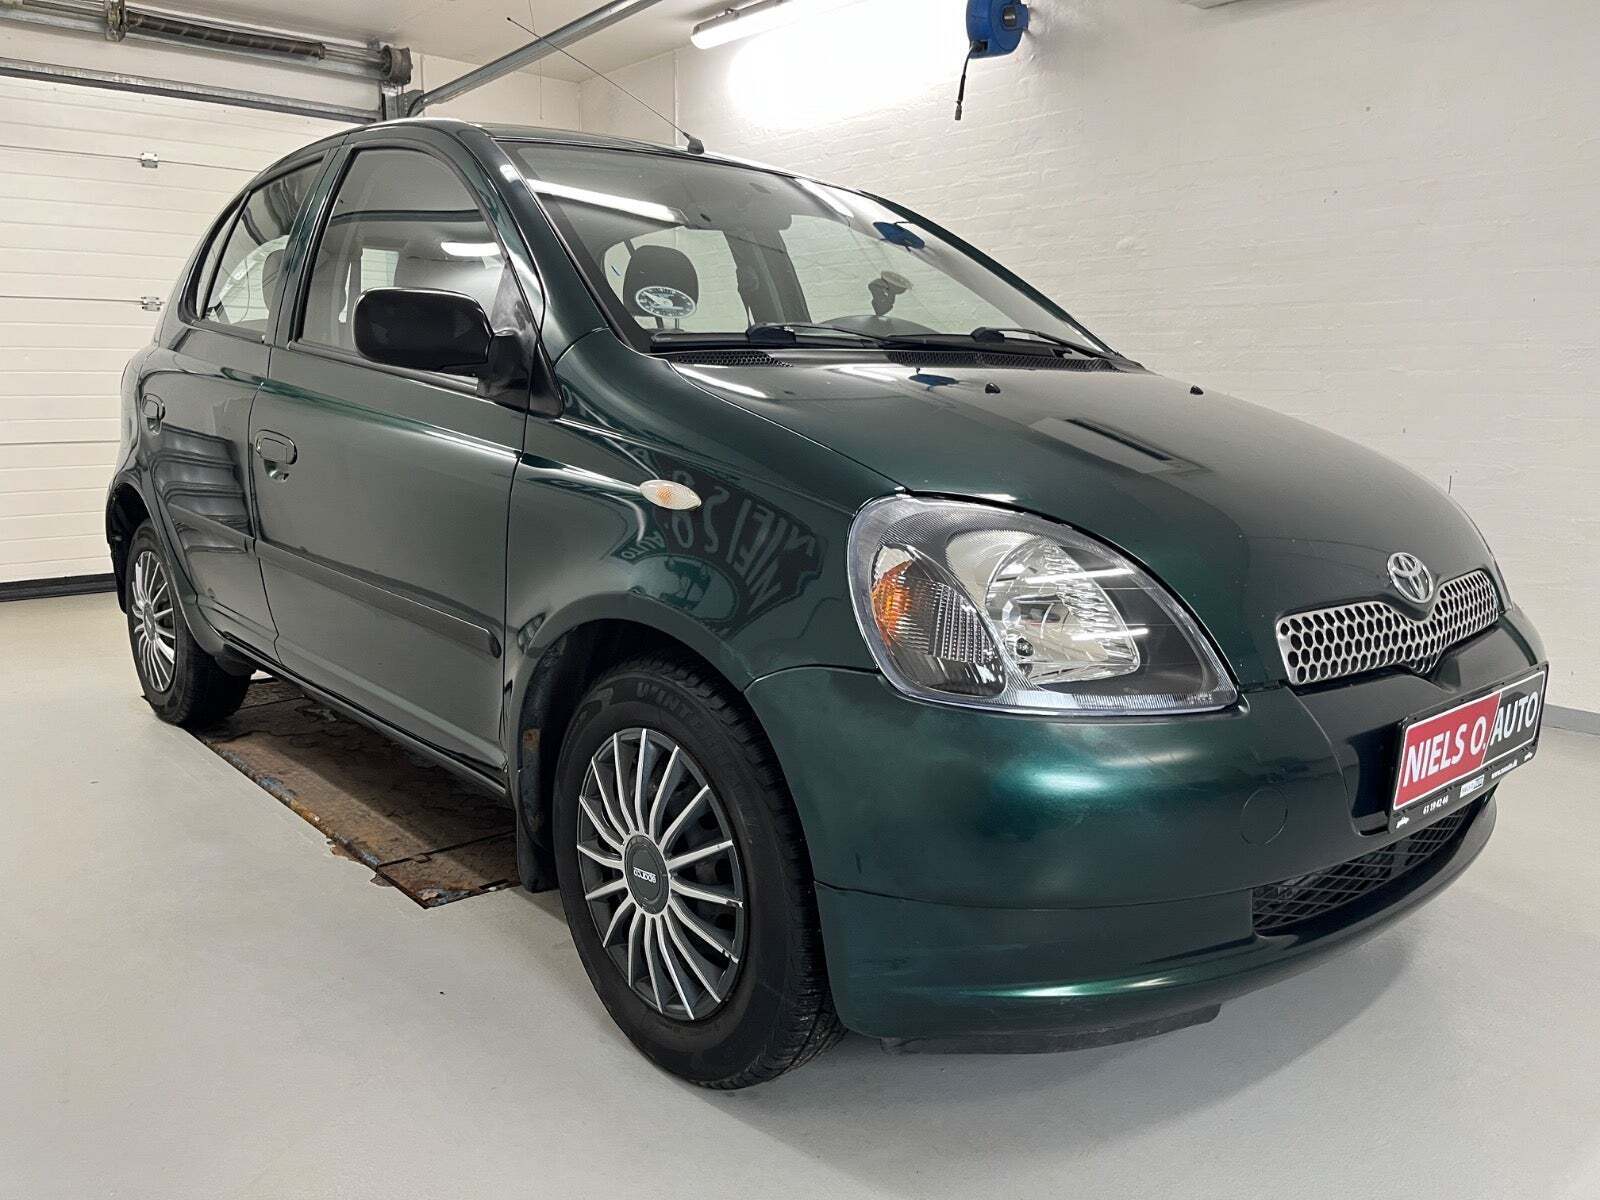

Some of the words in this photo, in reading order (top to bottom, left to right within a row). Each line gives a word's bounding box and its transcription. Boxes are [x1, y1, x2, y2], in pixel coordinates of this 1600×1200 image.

[1403, 723, 1468, 788] NIELS
[1470, 715, 1488, 756] O.
[1489, 691, 1539, 747] AUTO
